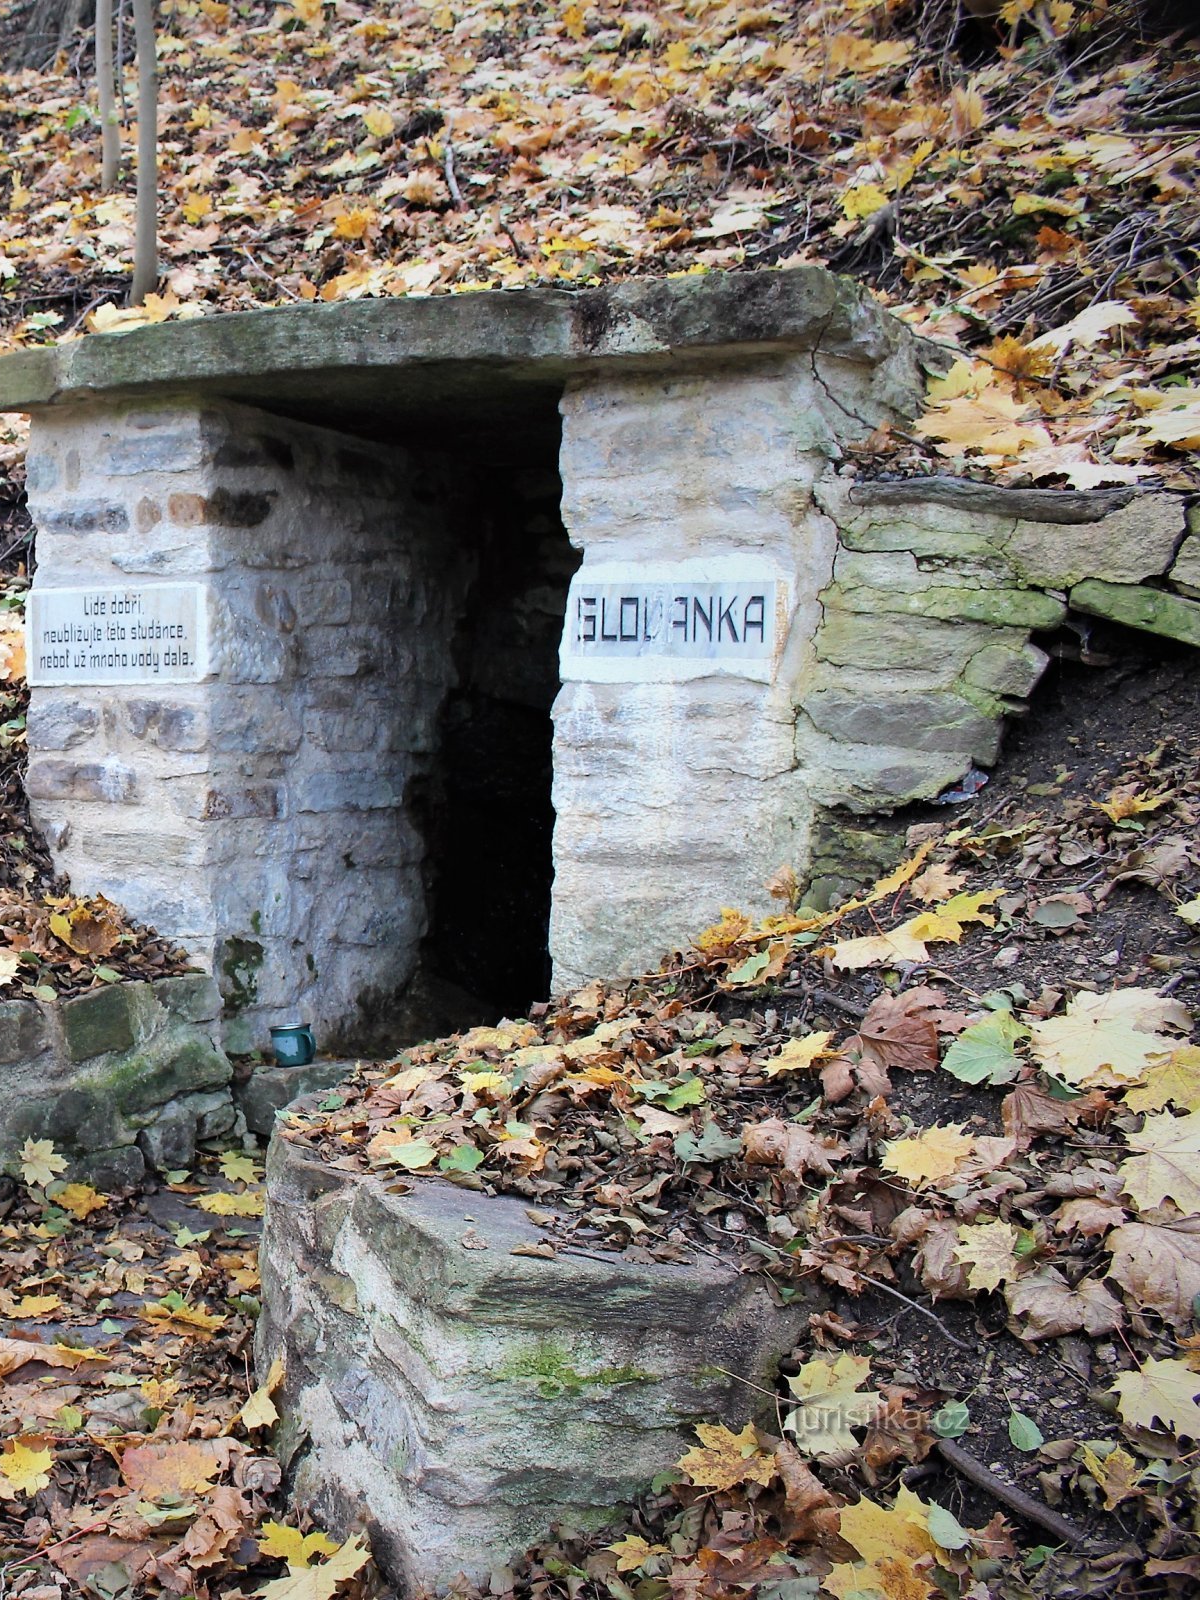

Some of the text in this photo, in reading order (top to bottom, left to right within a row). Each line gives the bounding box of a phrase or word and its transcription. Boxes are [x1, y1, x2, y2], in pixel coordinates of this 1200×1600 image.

[83, 595, 106, 616] Lidé
[43, 619, 188, 649] neubližujte této studánce,
[39, 645, 194, 673] neboť už mnoho vody dala.
